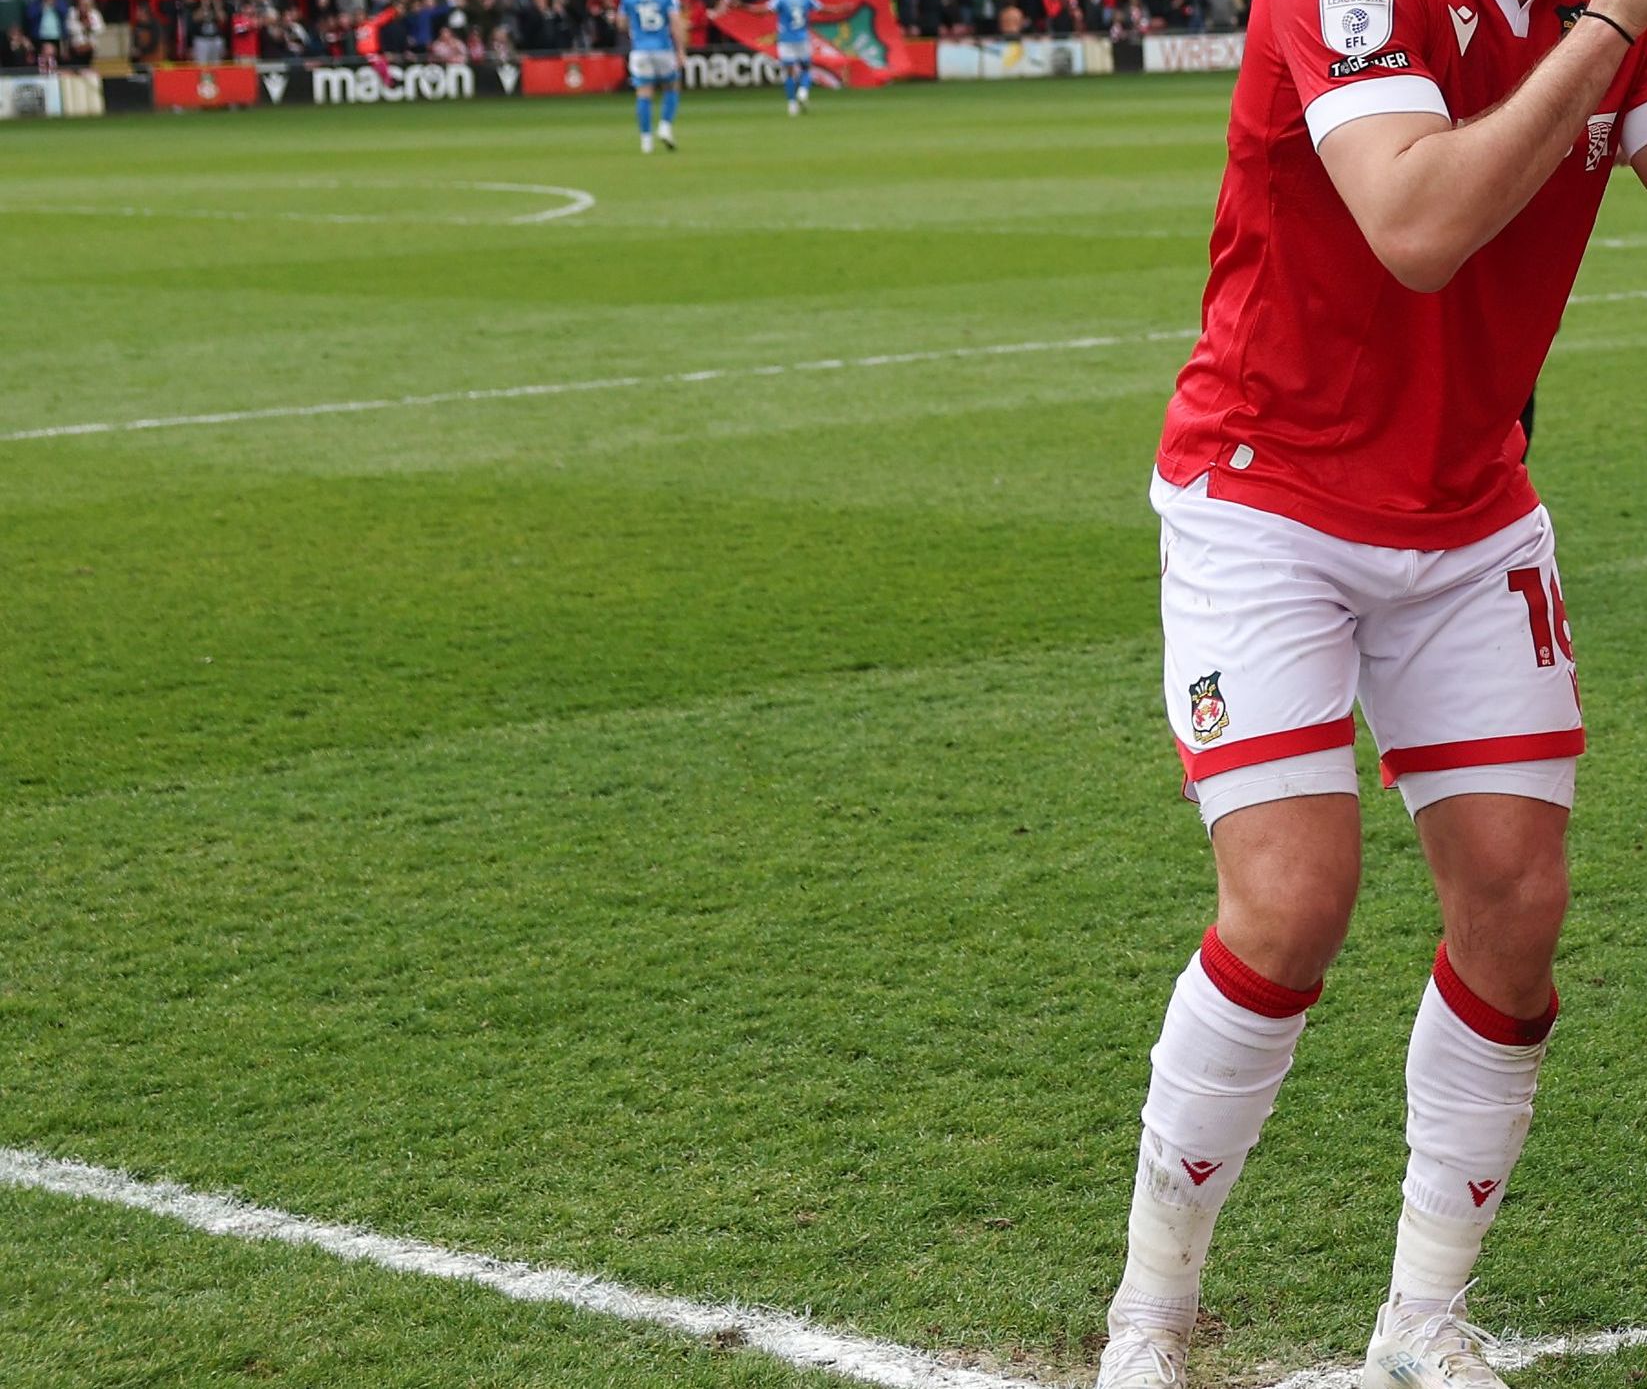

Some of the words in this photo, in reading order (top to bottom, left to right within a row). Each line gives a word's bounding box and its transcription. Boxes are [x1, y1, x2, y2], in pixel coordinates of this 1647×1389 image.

[635, 1, 666, 32] 15
[1345, 36, 1367, 49] EFL
[312, 63, 476, 104] macron
